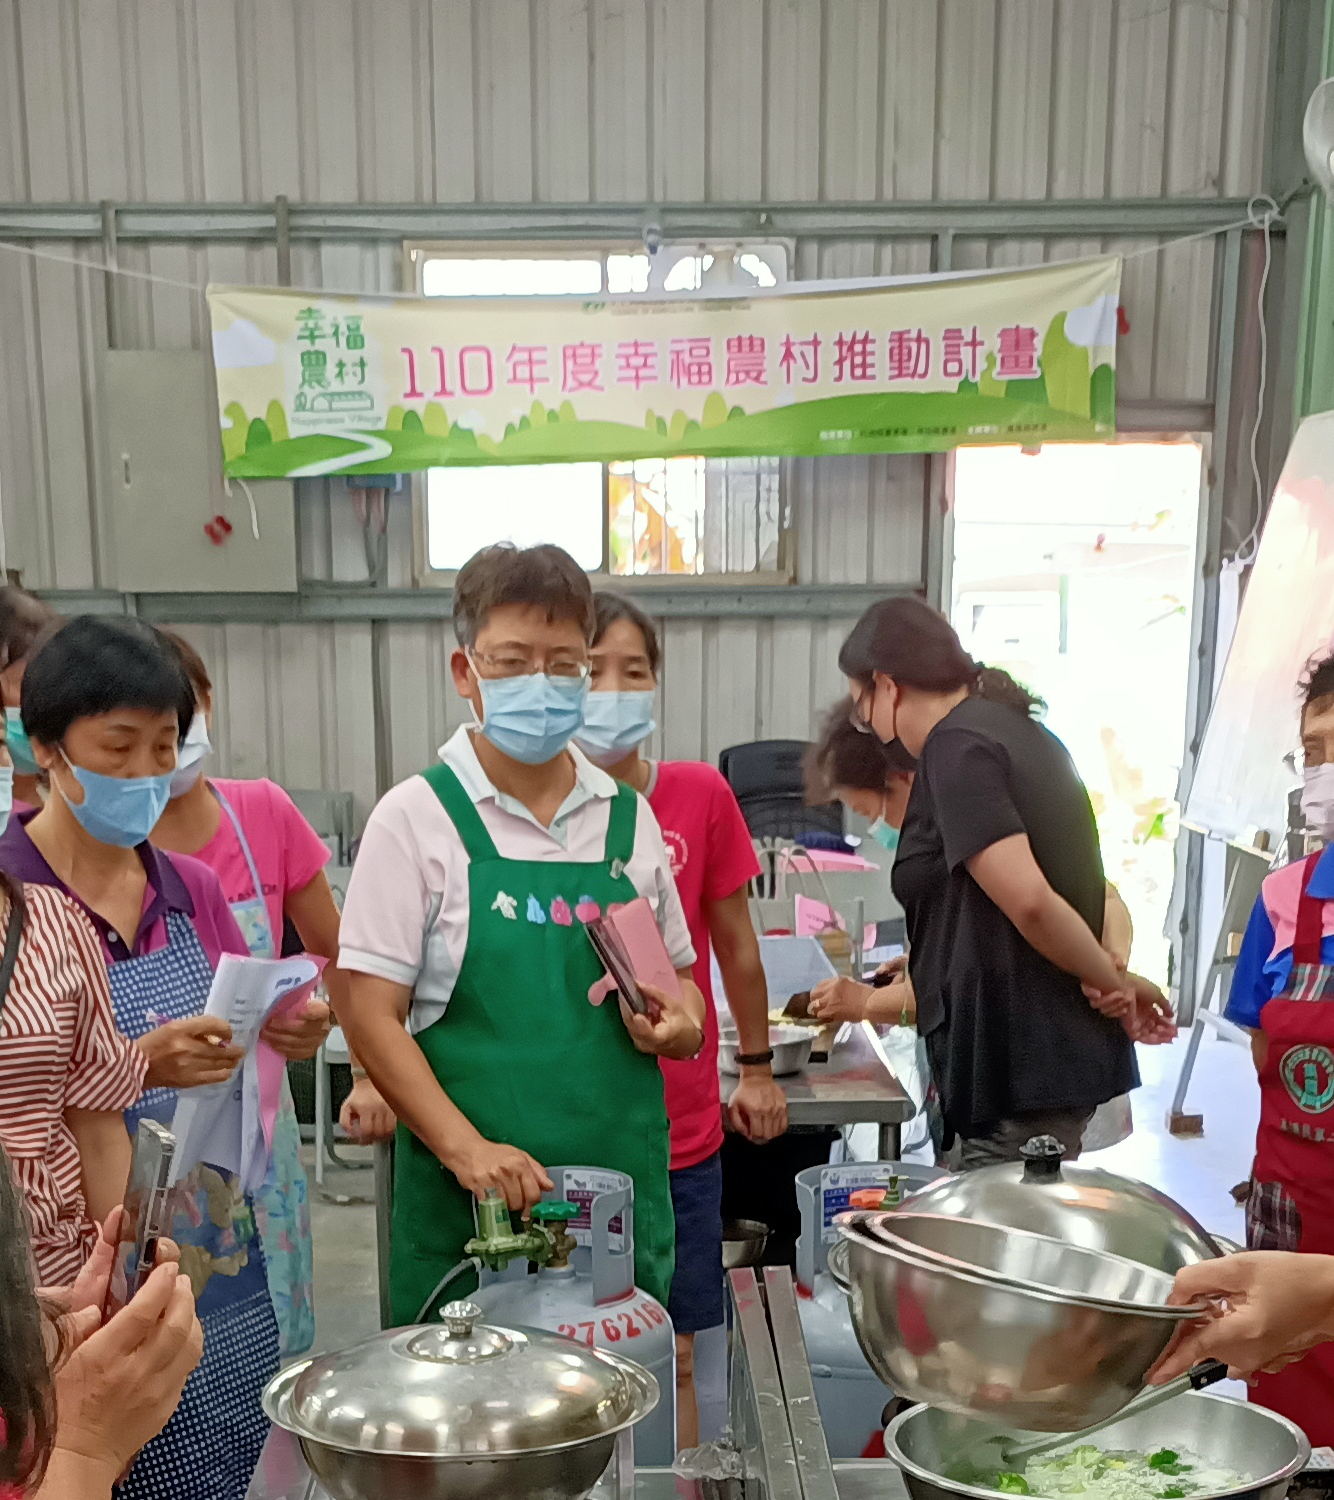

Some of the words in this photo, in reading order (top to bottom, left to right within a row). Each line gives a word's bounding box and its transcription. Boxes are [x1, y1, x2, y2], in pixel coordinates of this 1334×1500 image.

[296, 307, 365, 350] 幸福
[299, 350, 368, 389] 農村
[400, 325, 1041, 399] 110年度幸福農村推動計畫
